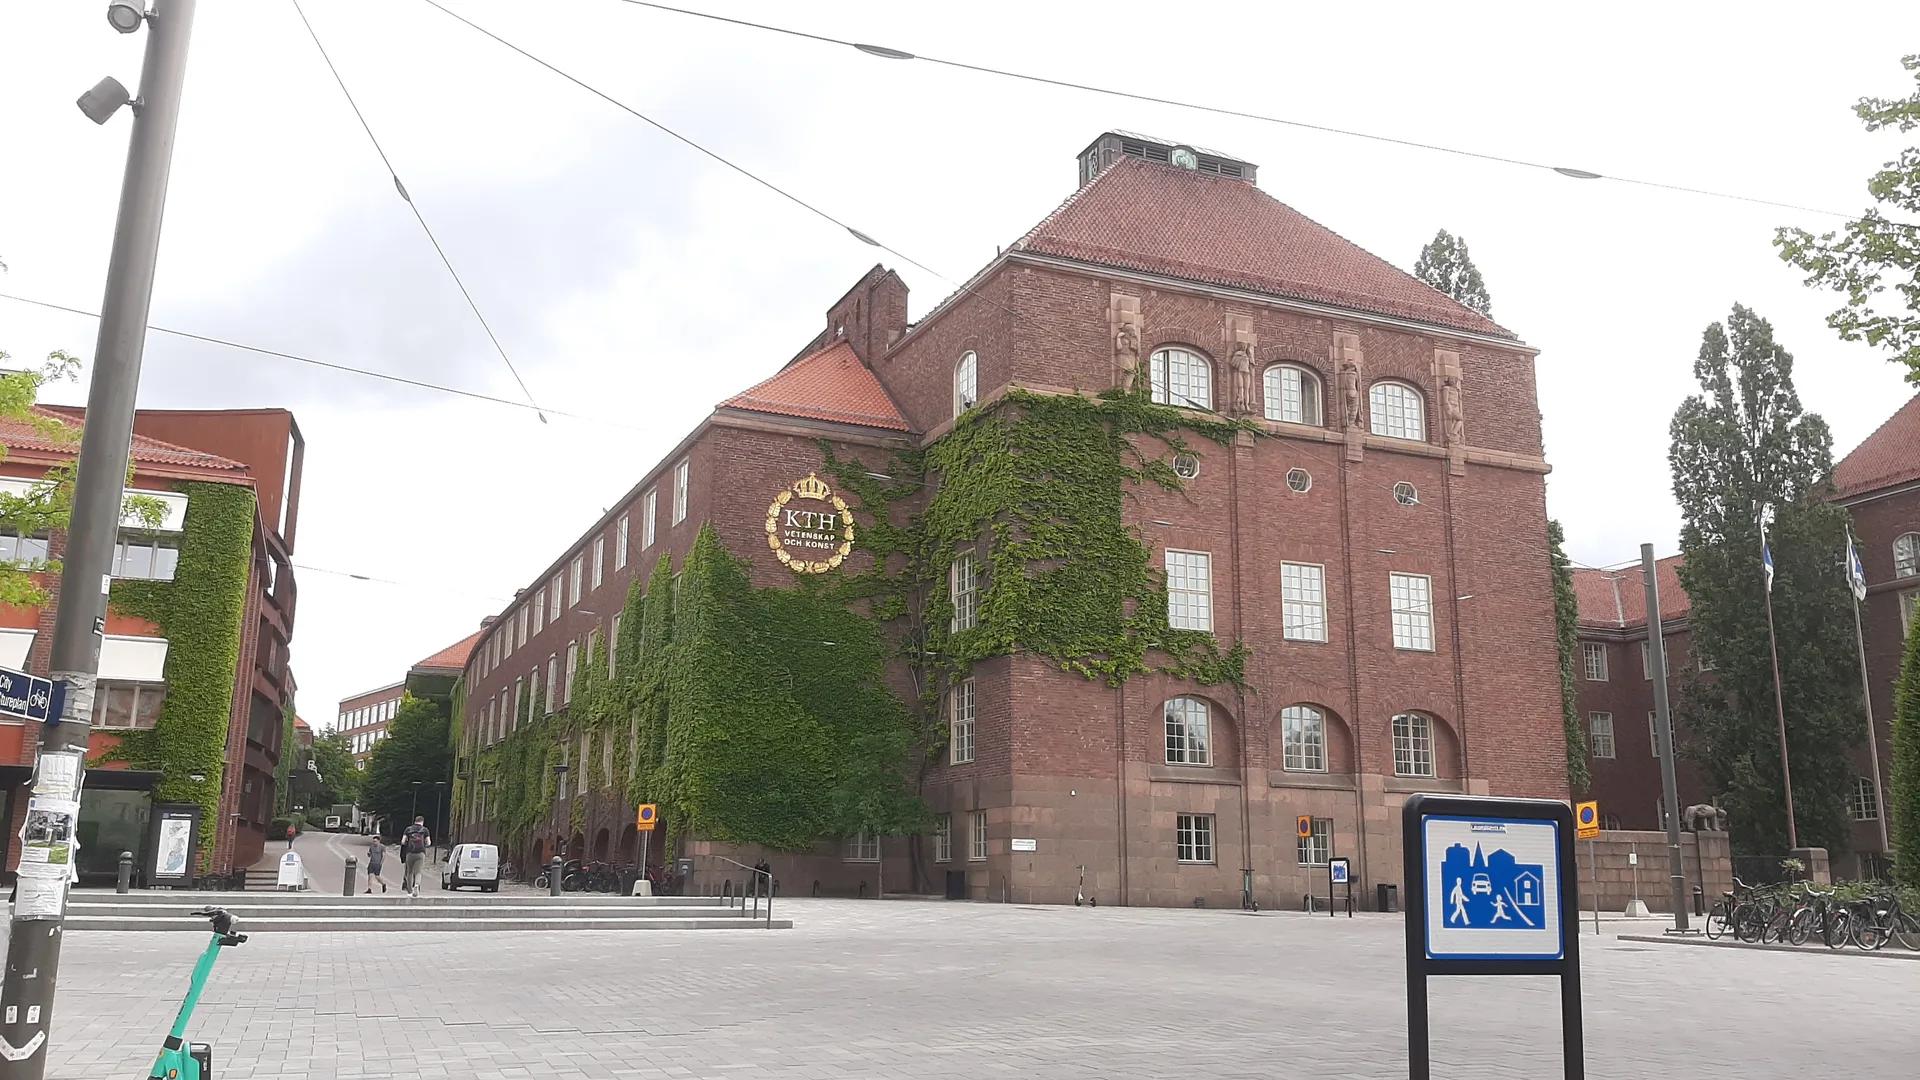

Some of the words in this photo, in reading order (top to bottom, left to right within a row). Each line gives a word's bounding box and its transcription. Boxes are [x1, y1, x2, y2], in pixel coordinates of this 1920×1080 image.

[784, 509, 836, 531] KTH
[784, 530, 835, 541] VETENSKAP
[784, 538, 802, 547] OCH
[805, 541, 835, 550] KONST
[0, 692, 26, 711] tureplan
